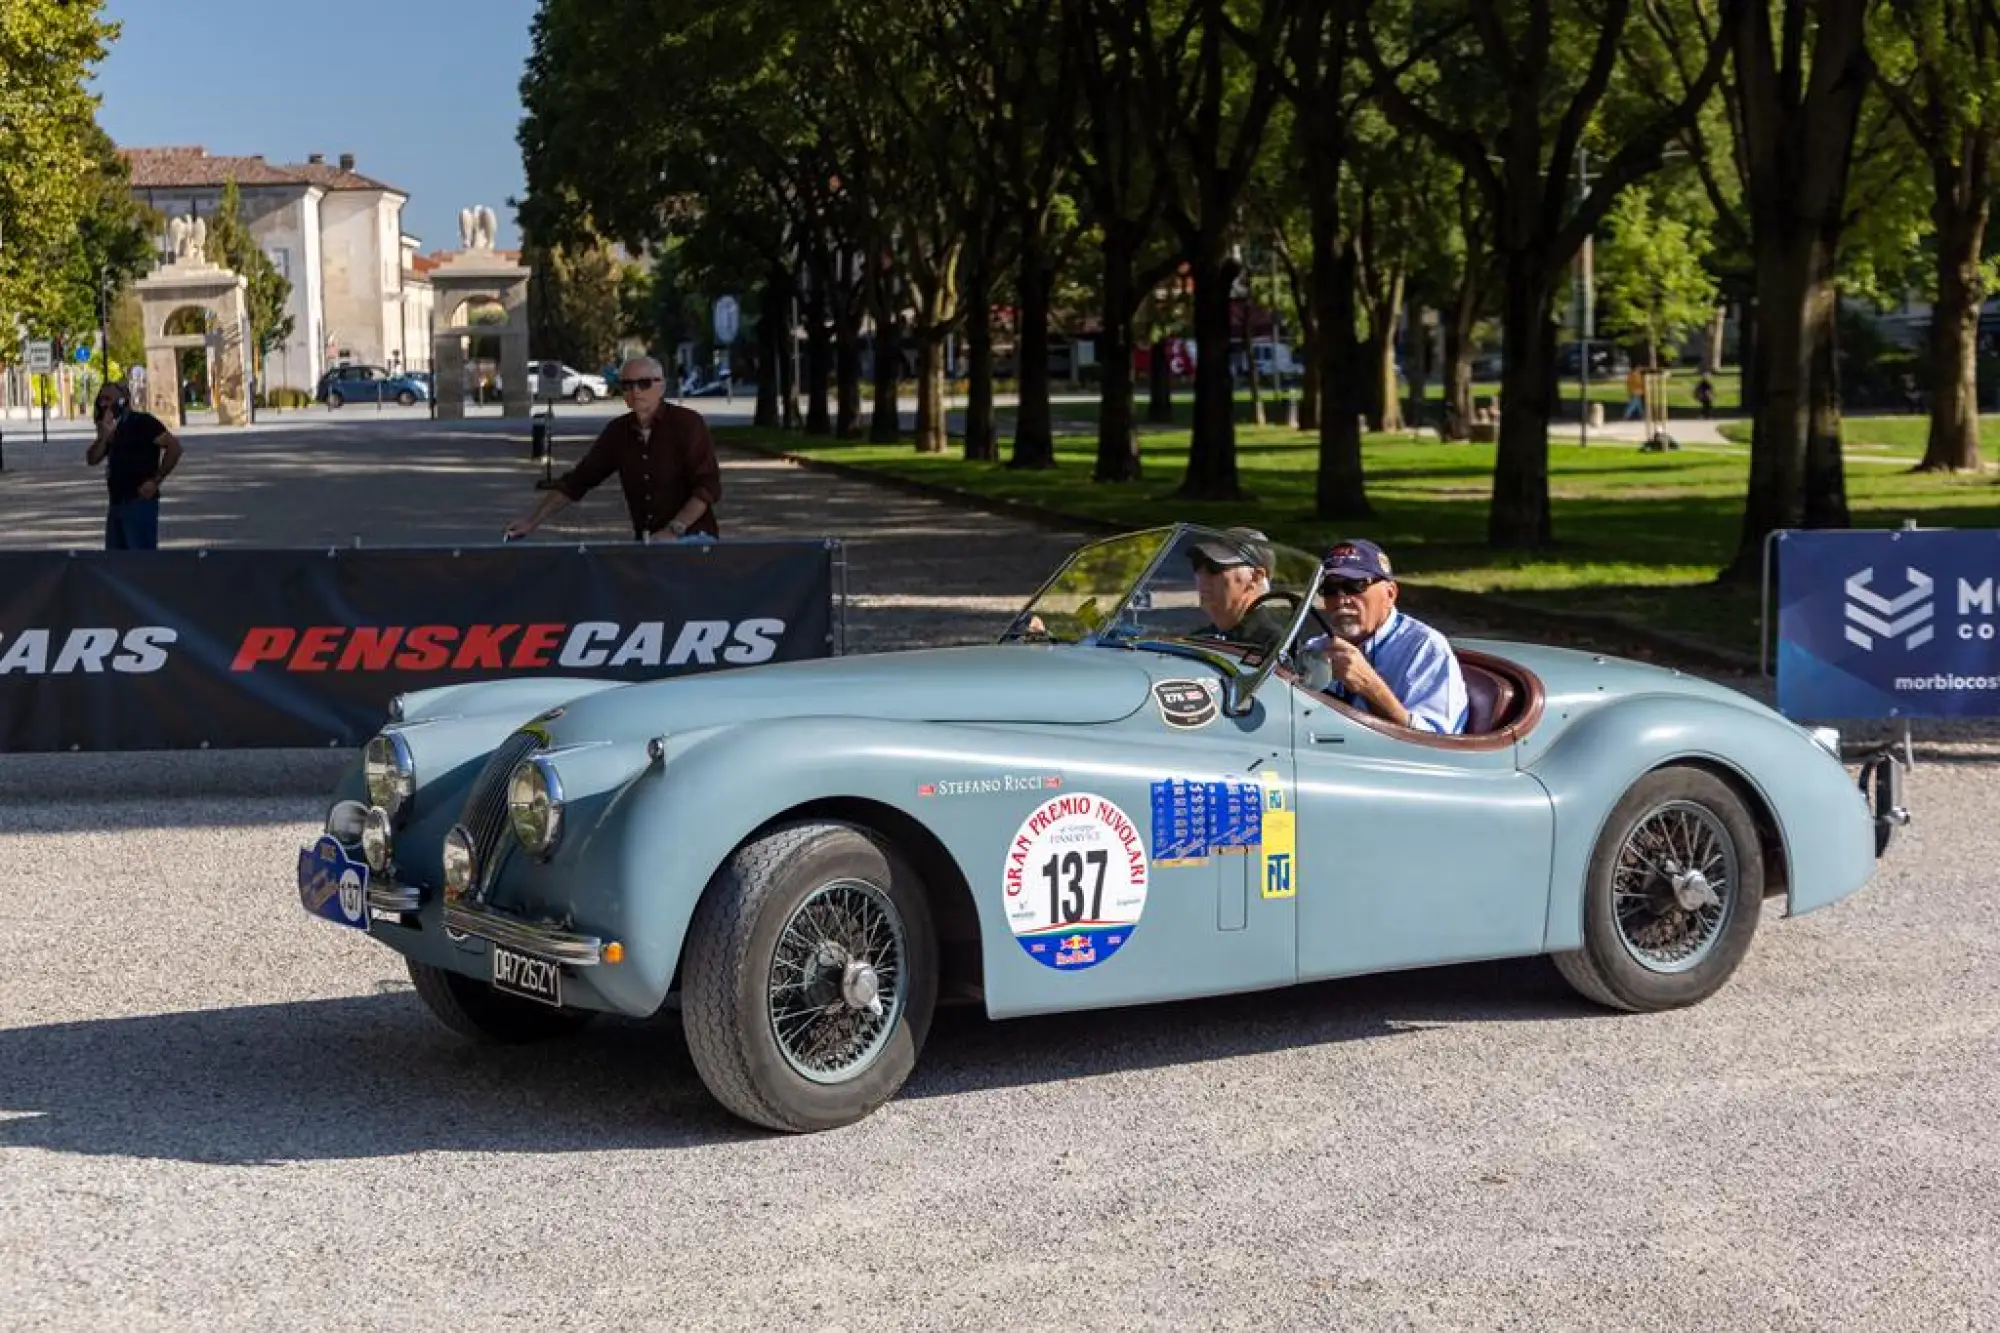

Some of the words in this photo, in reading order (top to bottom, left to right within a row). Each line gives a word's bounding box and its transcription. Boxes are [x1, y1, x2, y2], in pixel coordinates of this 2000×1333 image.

[1958, 578, 2000, 615] M
[0, 626, 178, 673] ARS
[230, 618, 785, 671] PENSKECARS
[938, 780, 1001, 795] STEFANO
[1004, 774, 1042, 791] RICCI
[1006, 834, 1032, 897] GRAN
[1028, 797, 1091, 836] PREMIO
[1095, 801, 1145, 885] NUVOLARI
[1042, 849, 1108, 924] 137
